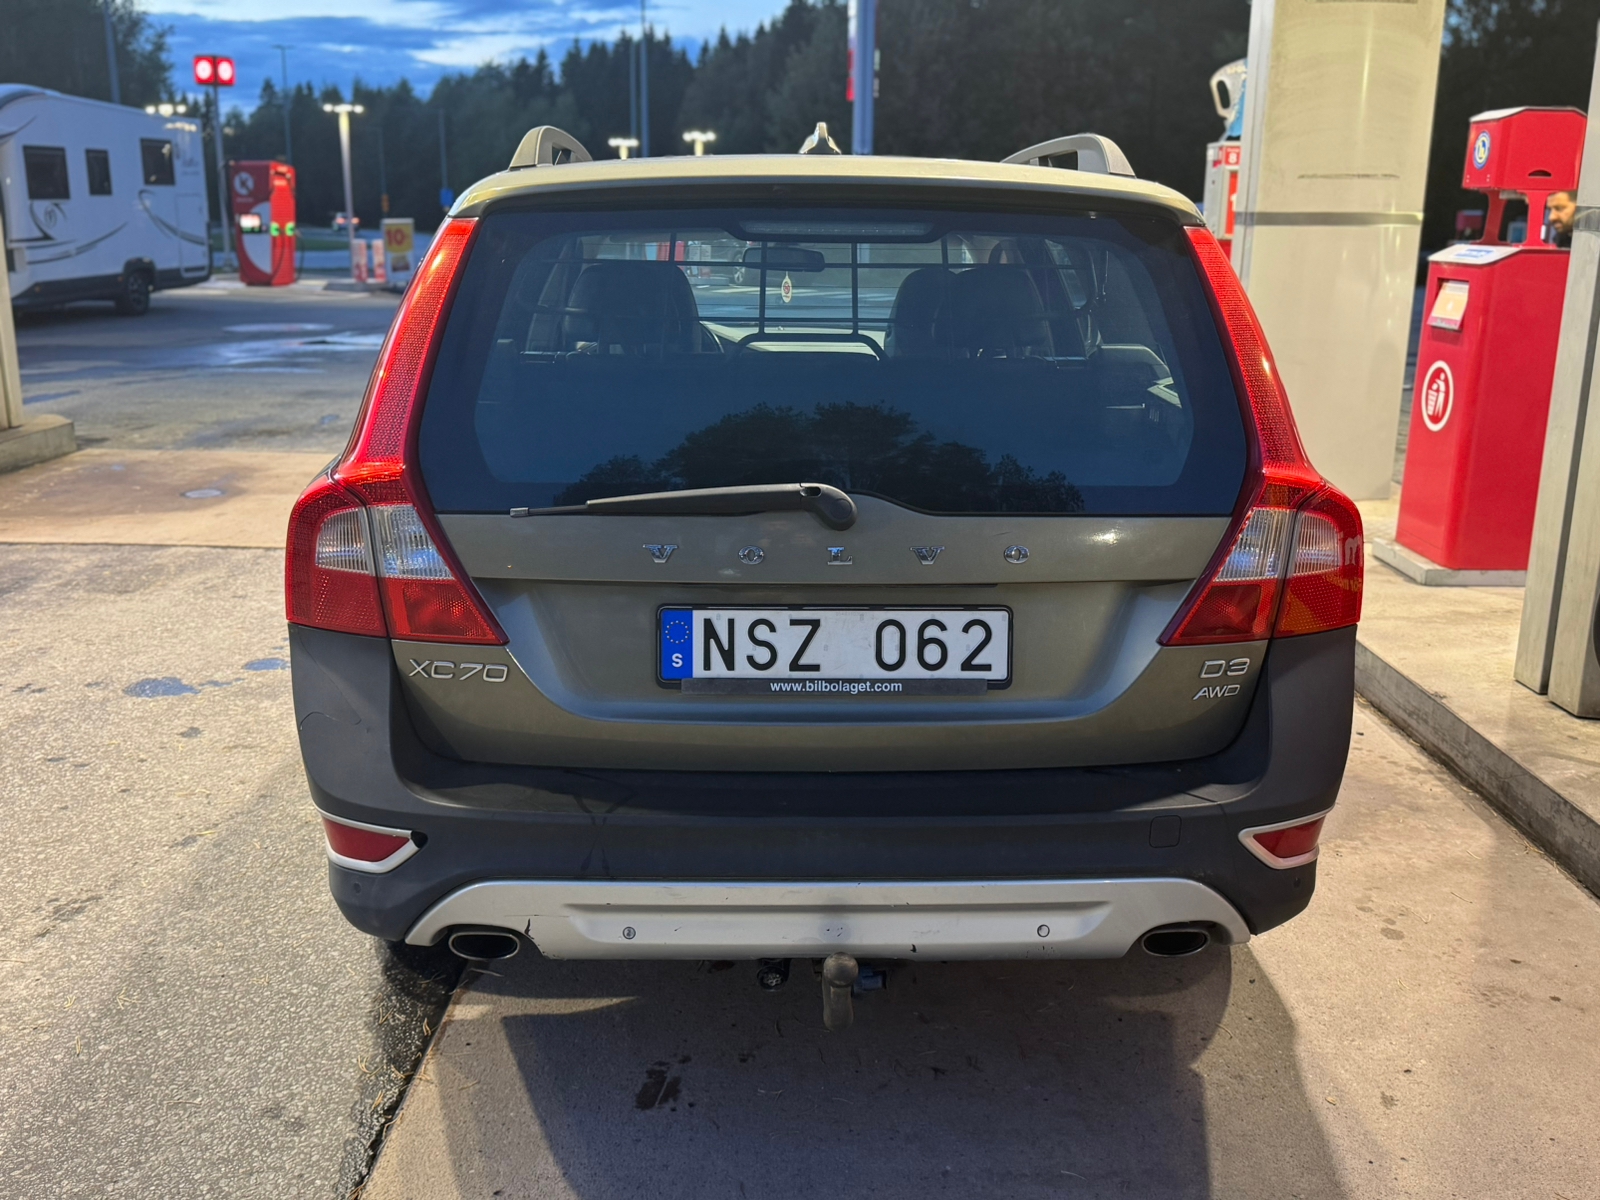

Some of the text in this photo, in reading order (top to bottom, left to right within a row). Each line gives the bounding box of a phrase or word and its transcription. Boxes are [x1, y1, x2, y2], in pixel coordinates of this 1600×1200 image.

[642, 543, 1030, 565] VOLVO
[703, 618, 993, 672] NSZ 062
[408, 659, 509, 683] XC70
[671, 653, 684, 668] S
[1200, 657, 1250, 679] D3
[770, 680, 903, 695] www.bilbolaget.com
[1192, 684, 1241, 701] AWD
